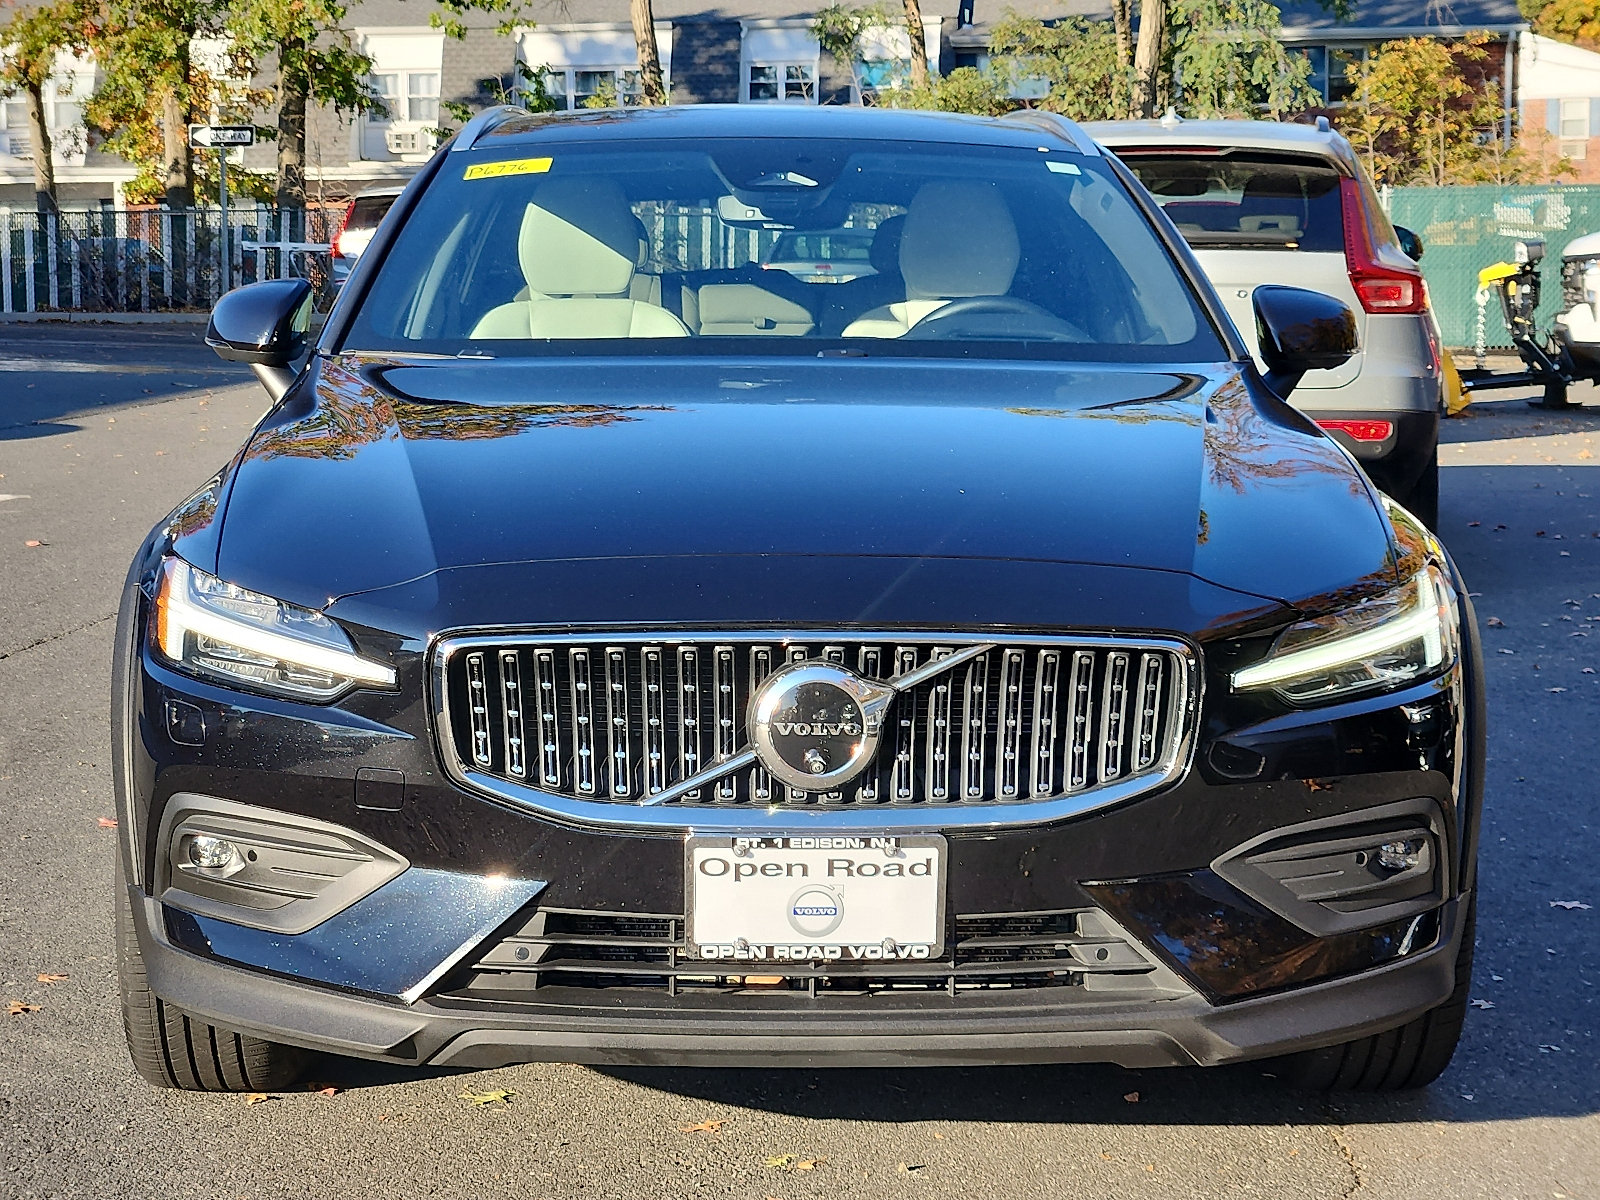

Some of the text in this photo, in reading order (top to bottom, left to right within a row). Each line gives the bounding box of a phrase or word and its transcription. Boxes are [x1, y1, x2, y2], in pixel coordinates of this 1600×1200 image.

[230, 132, 247, 141] WAY
[773, 722, 862, 736] VOLVO
[736, 837, 896, 849] RT. 1 EDISON, NJ
[699, 857, 933, 882] Open Road
[701, 945, 930, 959] OPEN ROAD VOLVO
